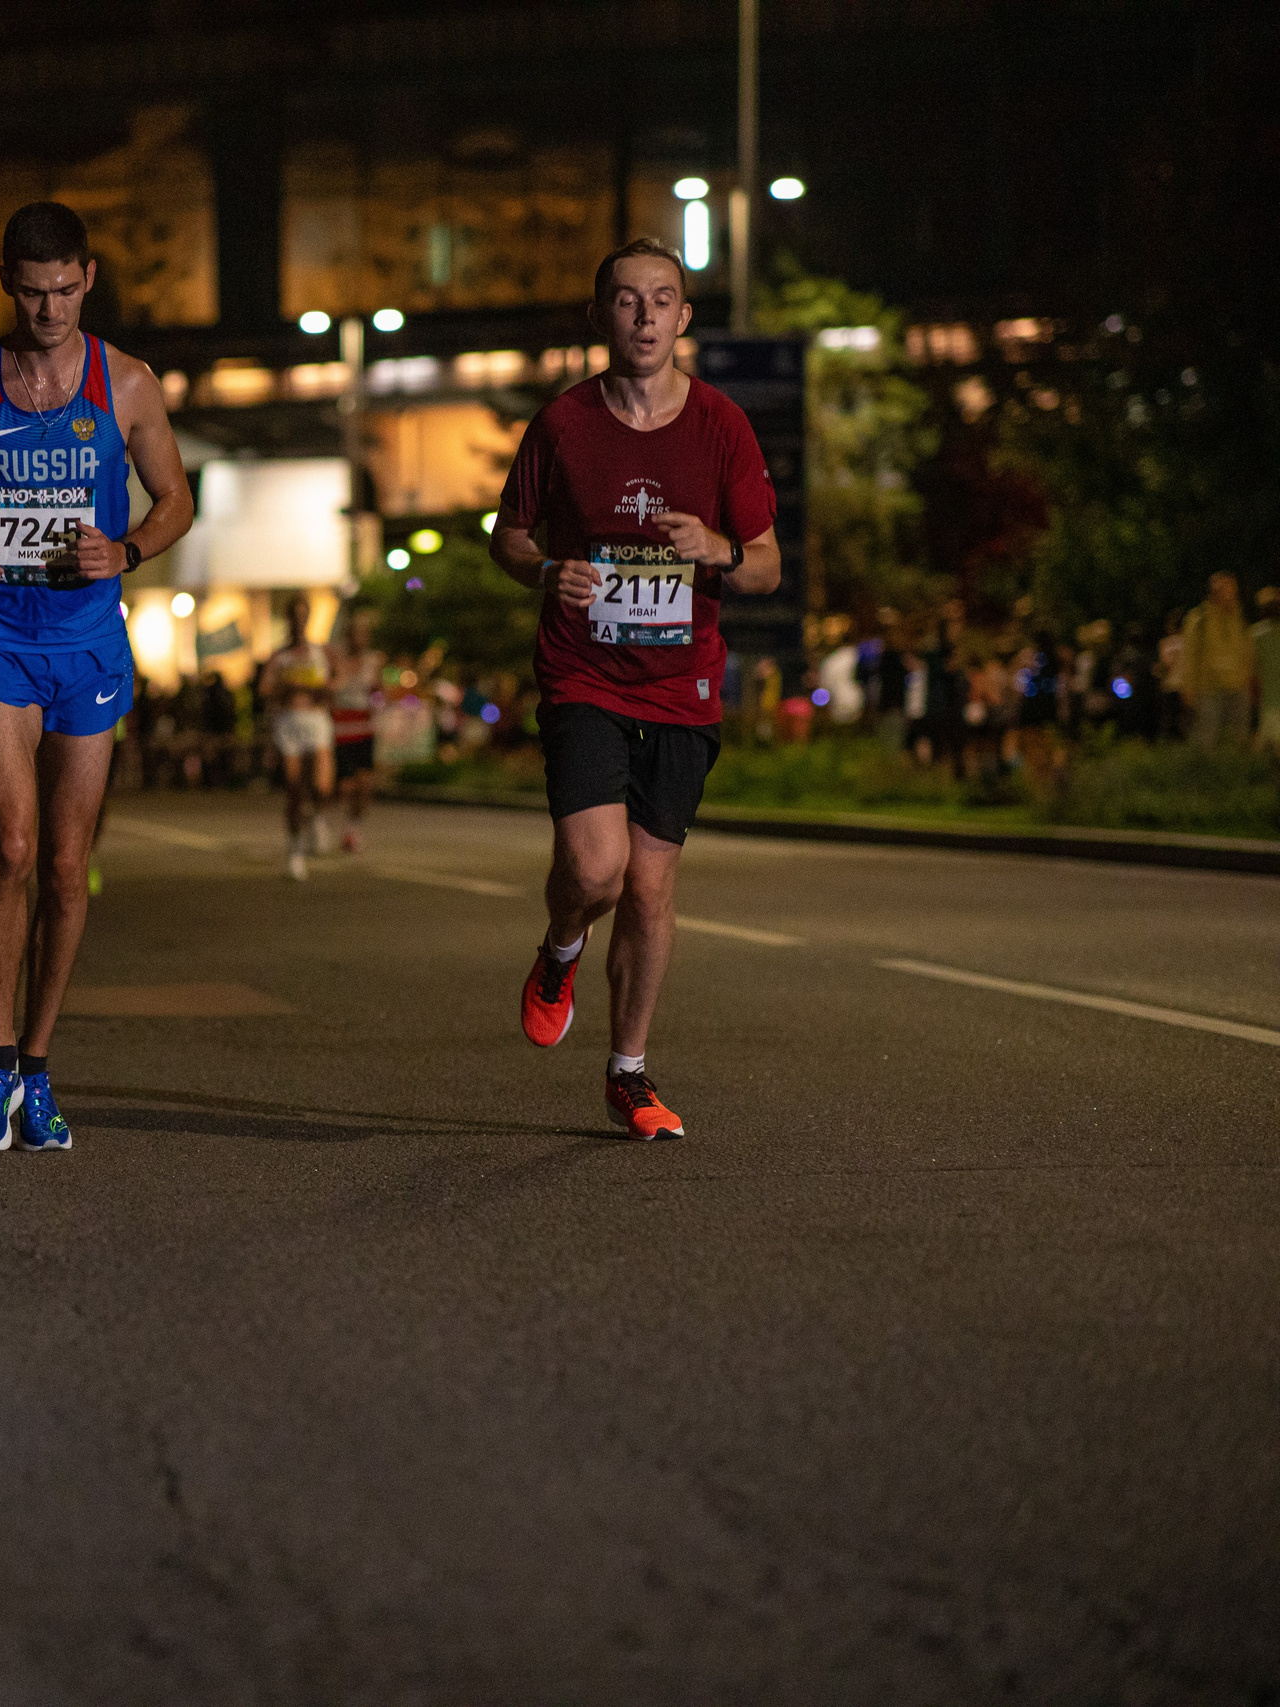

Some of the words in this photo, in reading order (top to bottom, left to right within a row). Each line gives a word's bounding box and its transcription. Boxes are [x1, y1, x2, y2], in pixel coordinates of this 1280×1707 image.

[625, 477, 645, 488] WORLD
[645, 478, 662, 489] CLASS
[614, 504, 671, 514] RUNNERS
[0, 516, 82, 548] 7245
[17, 549, 63, 560] МИХАИЛ
[603, 573, 683, 605] 2117
[628, 607, 657, 617] ИВАН
[600, 624, 613, 641] A
